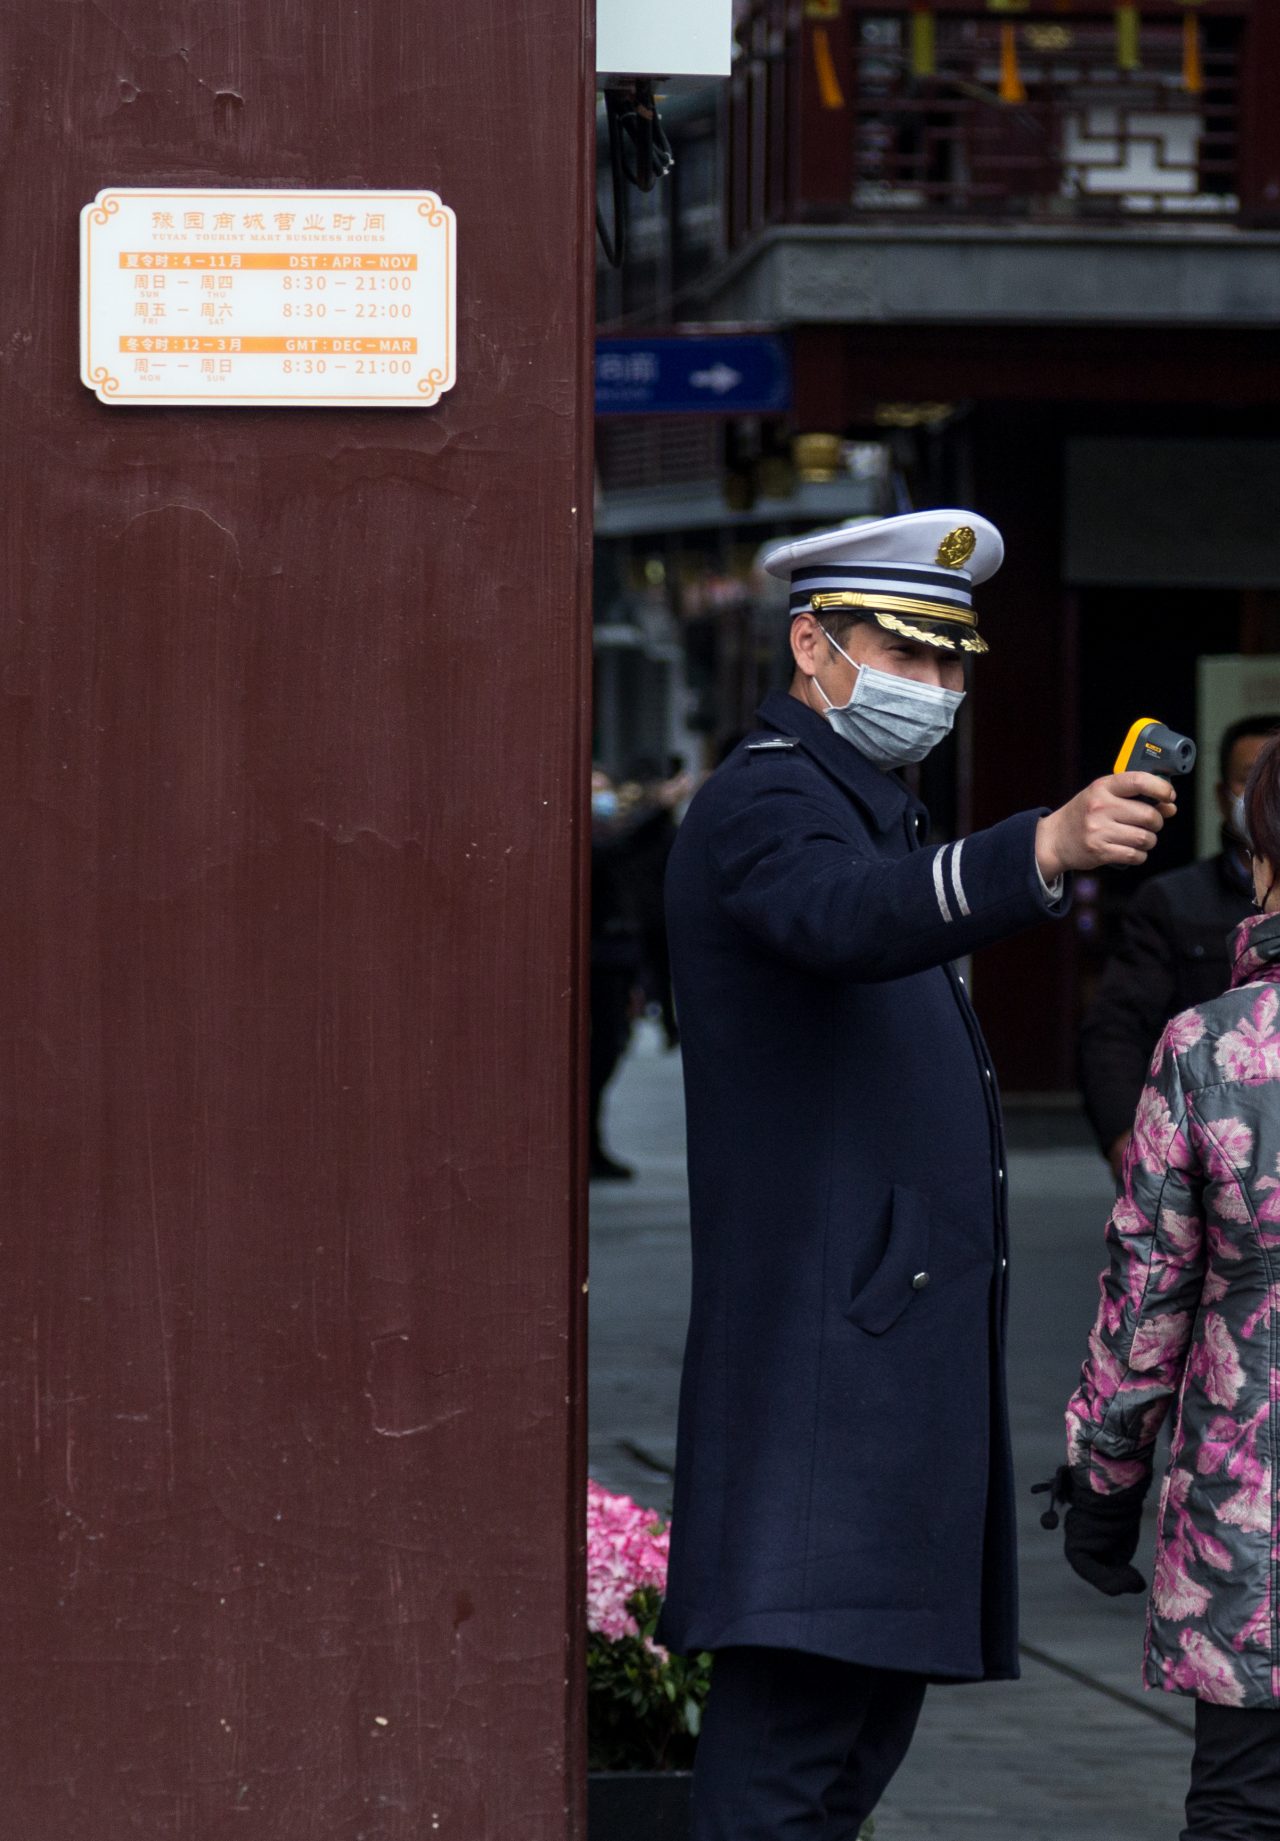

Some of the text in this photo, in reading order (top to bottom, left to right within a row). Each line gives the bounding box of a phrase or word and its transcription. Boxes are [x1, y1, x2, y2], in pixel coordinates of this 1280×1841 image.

[152, 211, 385, 231] 豫园商城营业时间
[196, 233, 244, 241] TOURIST
[286, 234, 342, 242] BUSINESS
[347, 234, 385, 242] HOURS
[282, 276, 327, 290] 8:30
[355, 276, 412, 290] 21:00
[282, 304, 327, 318] 8:30
[355, 304, 412, 318] 22:00
[282, 360, 327, 374] 8:30
[355, 360, 412, 374] 21:00
